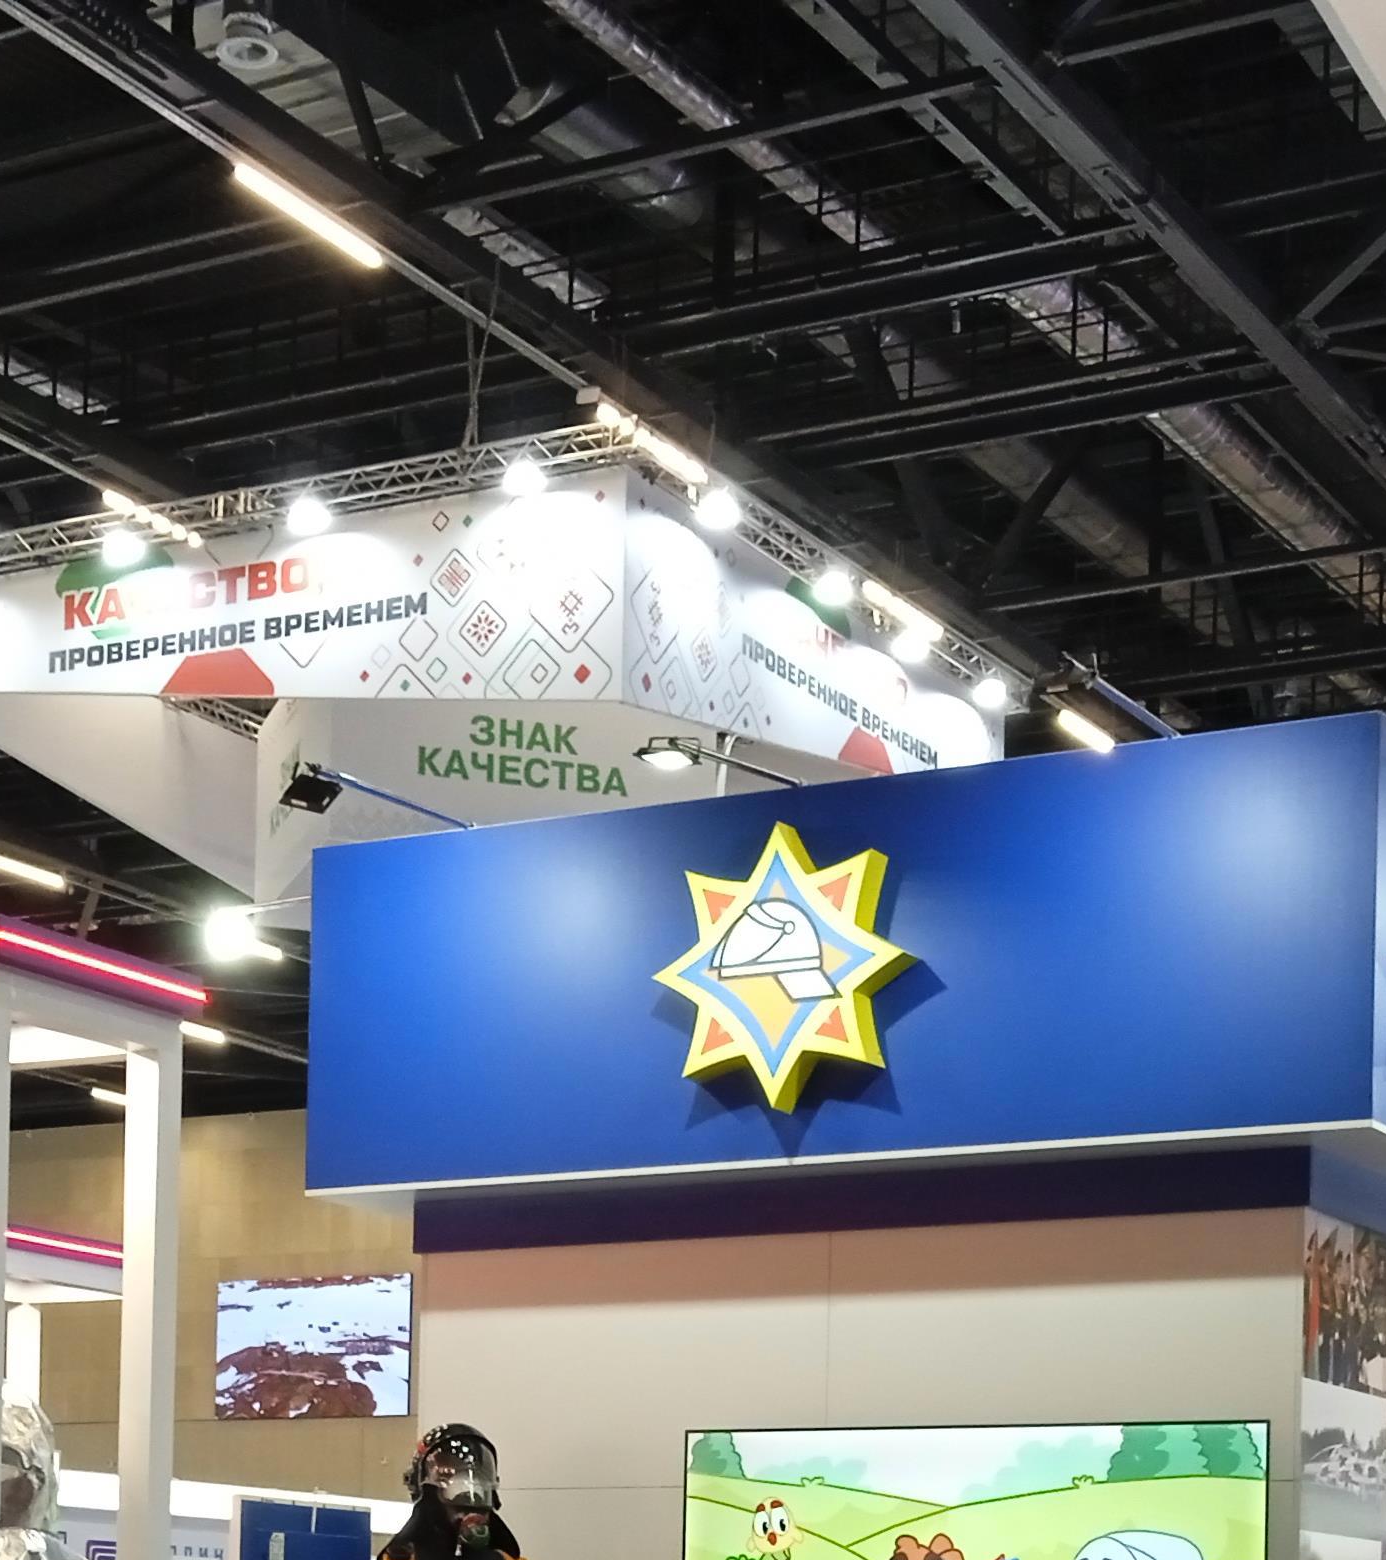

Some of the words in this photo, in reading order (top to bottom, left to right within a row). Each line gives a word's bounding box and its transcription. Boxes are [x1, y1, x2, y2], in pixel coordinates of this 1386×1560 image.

[48, 620, 256, 674] ПРОВЕРЕННОЕ
[263, 591, 428, 641] ВРЕМЕНЕМ
[741, 632, 859, 723] ПРОВЕРЕННОЕ
[861, 705, 939, 769] ВРЕМЕНЕМ
[468, 714, 579, 756] ЗНАК
[416, 745, 629, 798] КАЧЕСТВА
